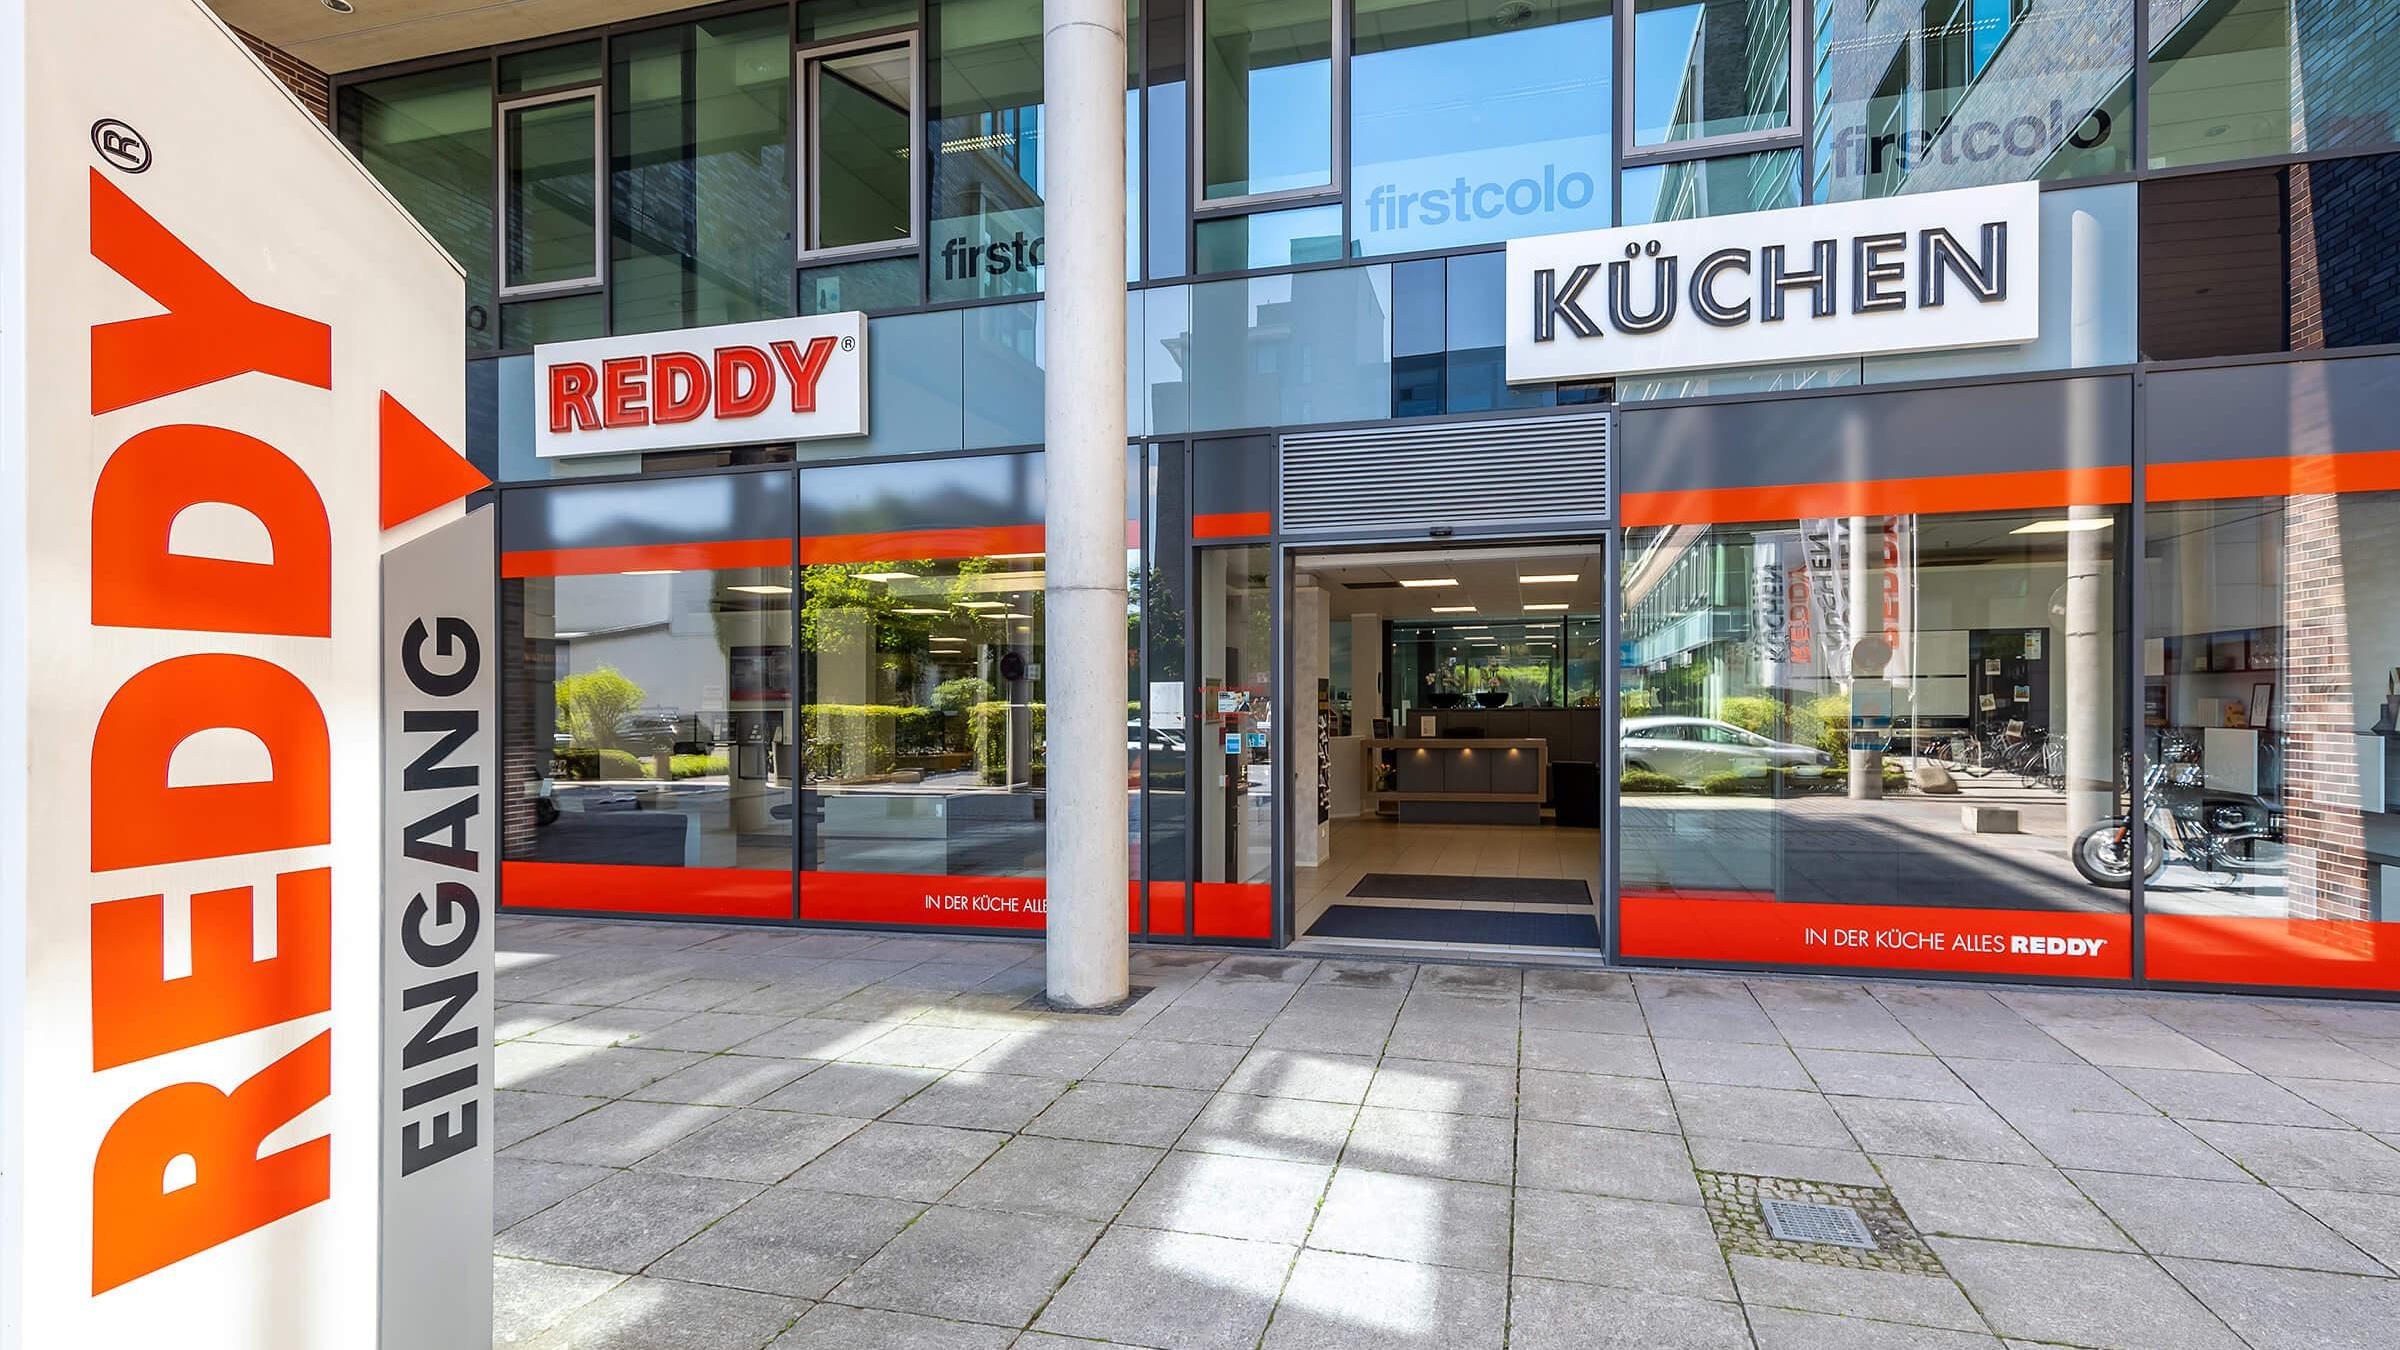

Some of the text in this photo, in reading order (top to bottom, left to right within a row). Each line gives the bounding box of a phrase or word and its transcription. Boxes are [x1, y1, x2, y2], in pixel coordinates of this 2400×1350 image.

[1830, 99, 2112, 178] firstcolo
[1365, 163, 1595, 233] firstcolo
[1533, 220, 2009, 343] KÜCHEN
[401, 617, 481, 1178] EINGANG
[925, 894, 940, 909] IN
[944, 895, 968, 910] DER
[972, 894, 1019, 912] KÜCHE
[1805, 928, 1826, 945] IN
[1834, 929, 1868, 948] DER
[1876, 928, 1944, 950] KÜCHE
[1952, 935, 2005, 953] ALLES
